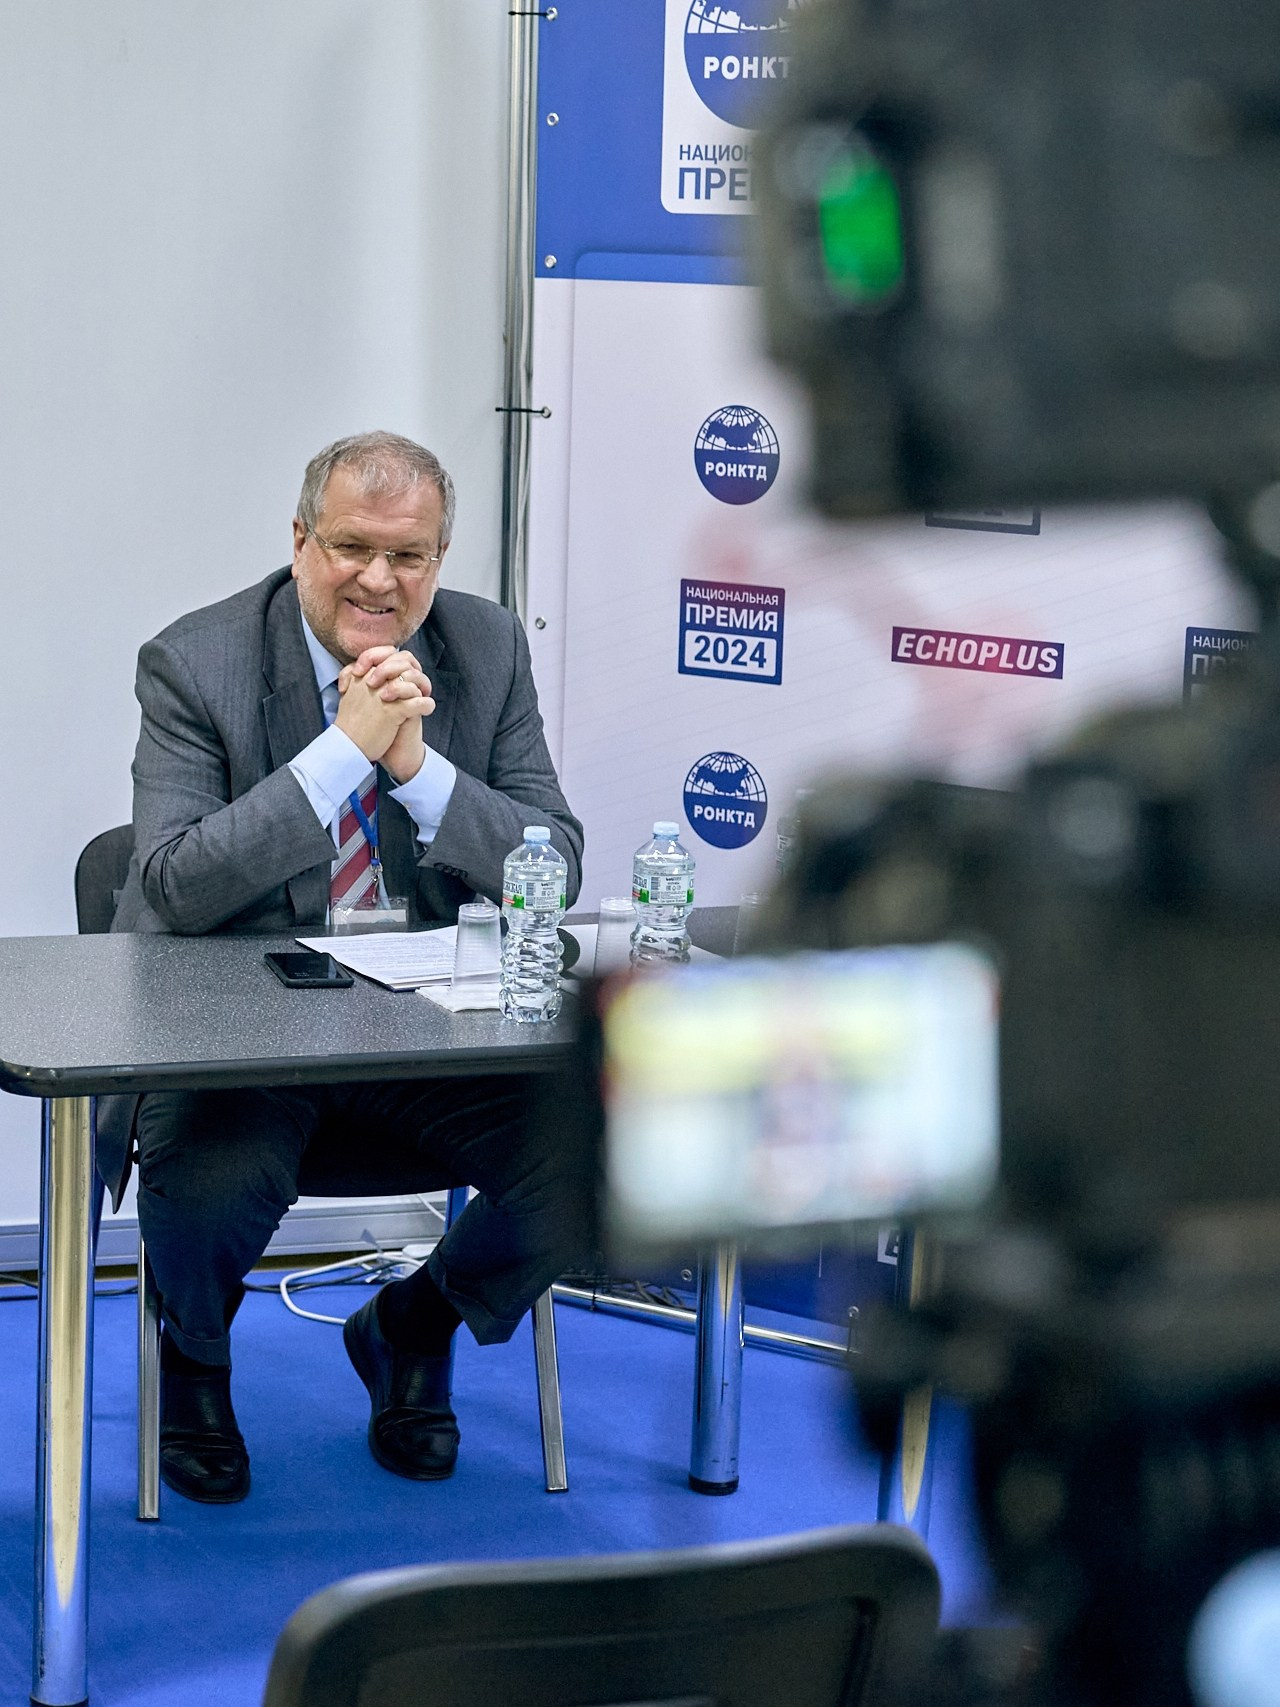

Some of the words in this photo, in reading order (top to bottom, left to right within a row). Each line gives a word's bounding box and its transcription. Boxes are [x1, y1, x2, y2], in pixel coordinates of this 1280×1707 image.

[678, 167, 751, 201] ПРЕ
[705, 461, 767, 481] РОНКТД
[686, 586, 779, 606] НАЦИОНАЛЬНАЯ
[685, 602, 778, 632] ПРЕМИЯ
[694, 635, 767, 668] 2024
[896, 633, 1059, 673] ECHOPLUS
[693, 804, 756, 828] РОНКТД
